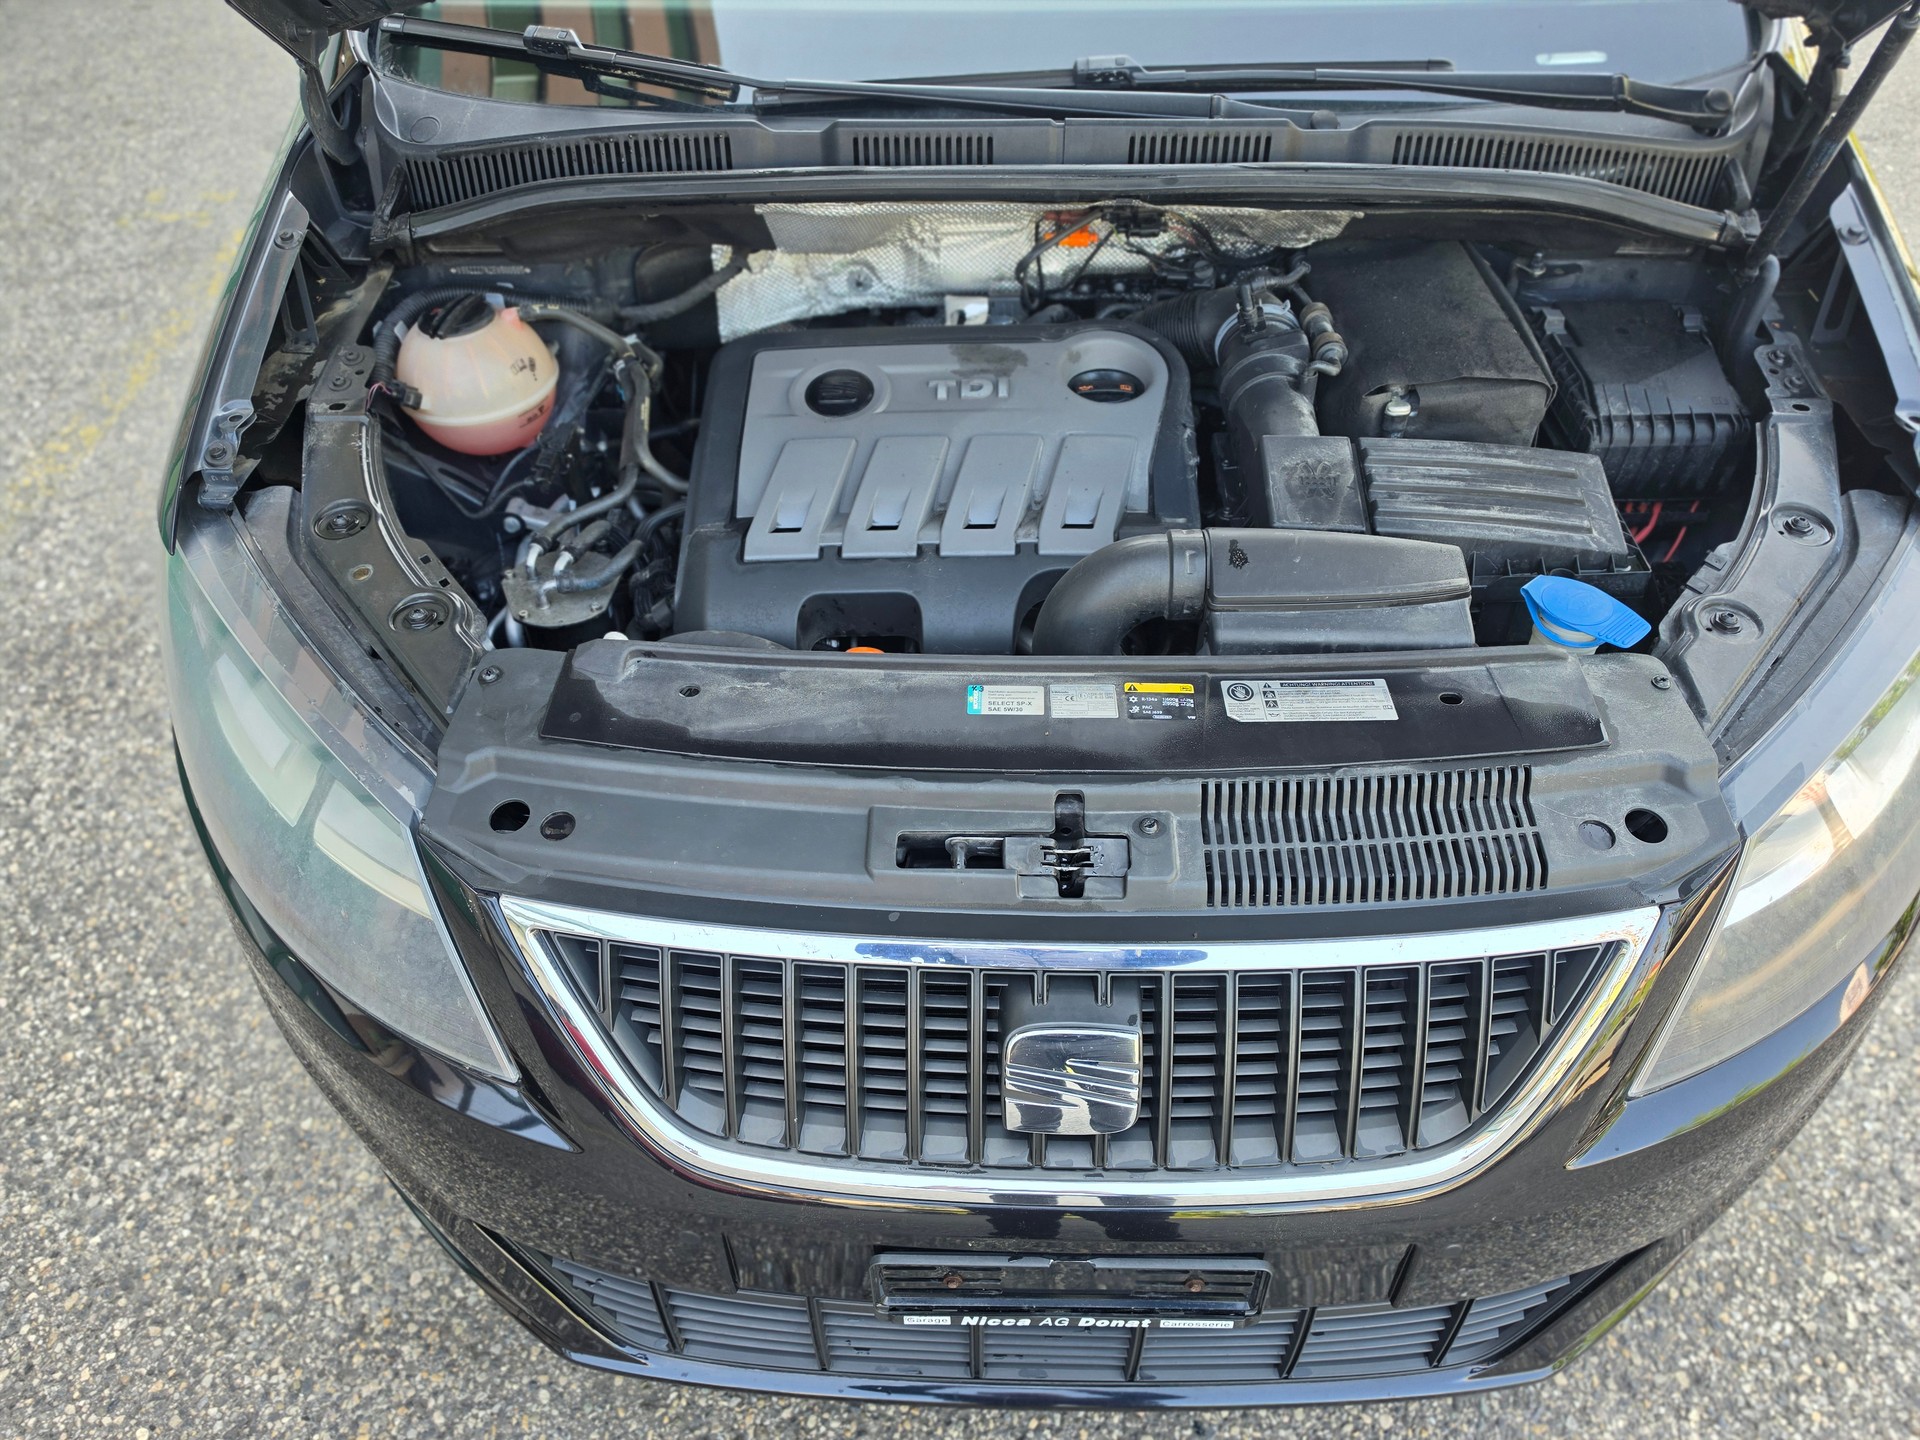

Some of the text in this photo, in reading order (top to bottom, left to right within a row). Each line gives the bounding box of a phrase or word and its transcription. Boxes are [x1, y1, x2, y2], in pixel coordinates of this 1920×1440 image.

[926, 378, 1009, 401] TDI
[905, 1317, 948, 1325] Garage
[961, 1316, 1031, 1326] Nicca
[1039, 1317, 1070, 1326] AG
[1078, 1318, 1151, 1328] Donat
